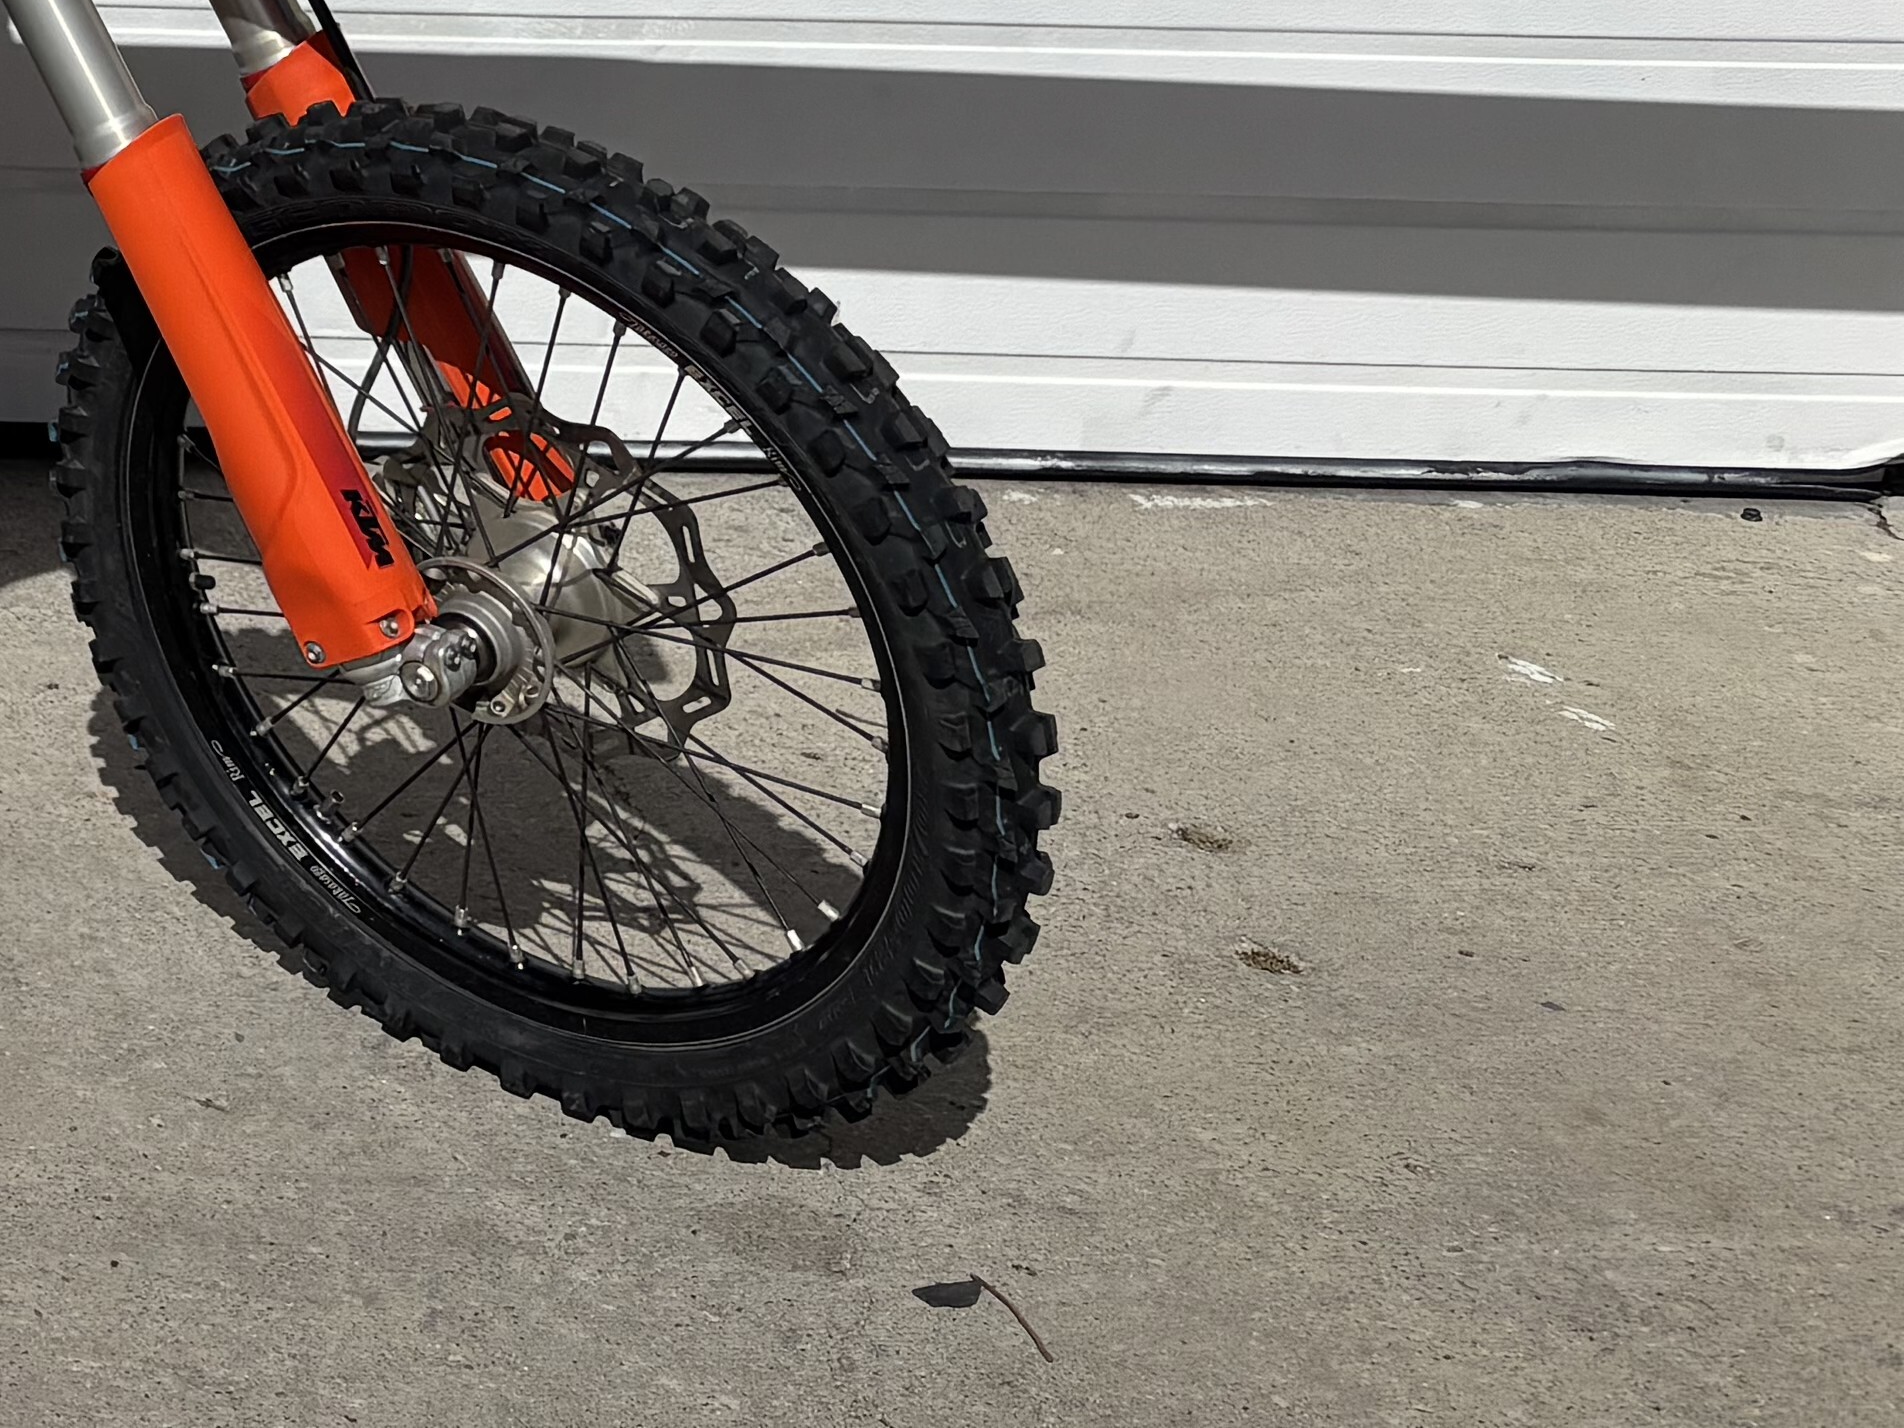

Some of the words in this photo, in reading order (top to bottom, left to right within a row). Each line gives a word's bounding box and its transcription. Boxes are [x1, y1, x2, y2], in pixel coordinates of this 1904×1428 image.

[685, 365, 753, 436] EXCEL
[340, 489, 395, 568] KTM
[211, 740, 245, 782] Rim
[248, 790, 309, 862] EXCEL
